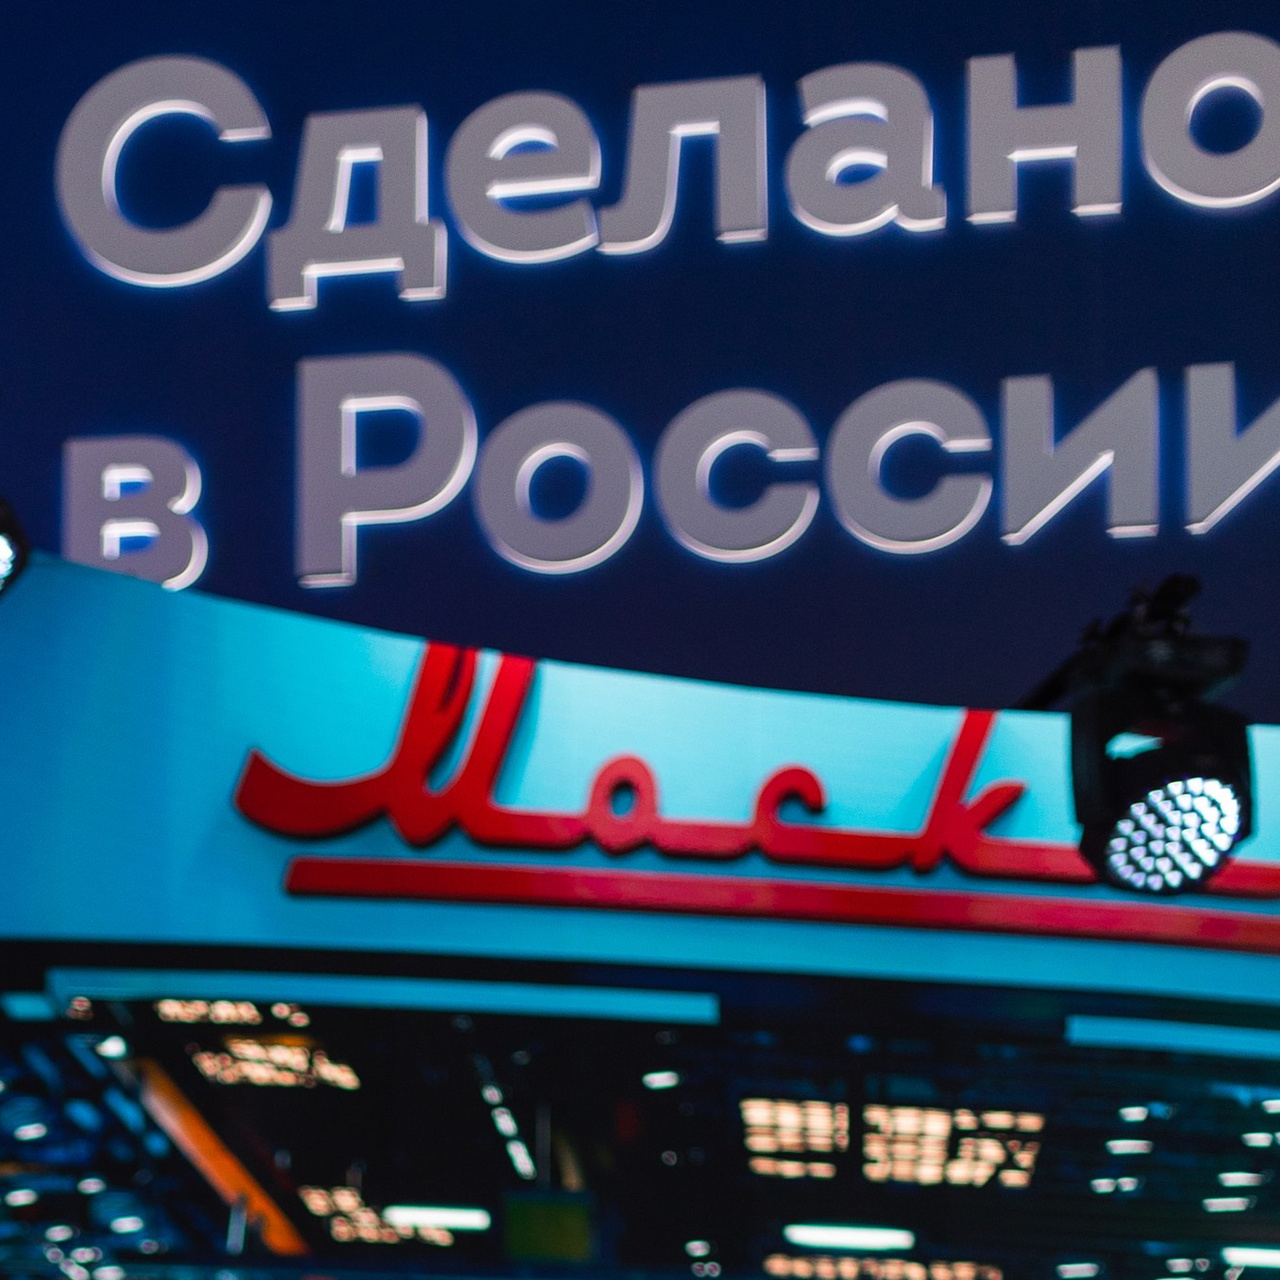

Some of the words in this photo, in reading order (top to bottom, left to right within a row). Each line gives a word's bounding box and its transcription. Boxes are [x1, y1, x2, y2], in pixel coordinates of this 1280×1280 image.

[56, 30, 1280, 312] Сделано
[61, 433, 210, 590] в
[295, 351, 1280, 588] России
[233, 640, 1096, 878] Моск
